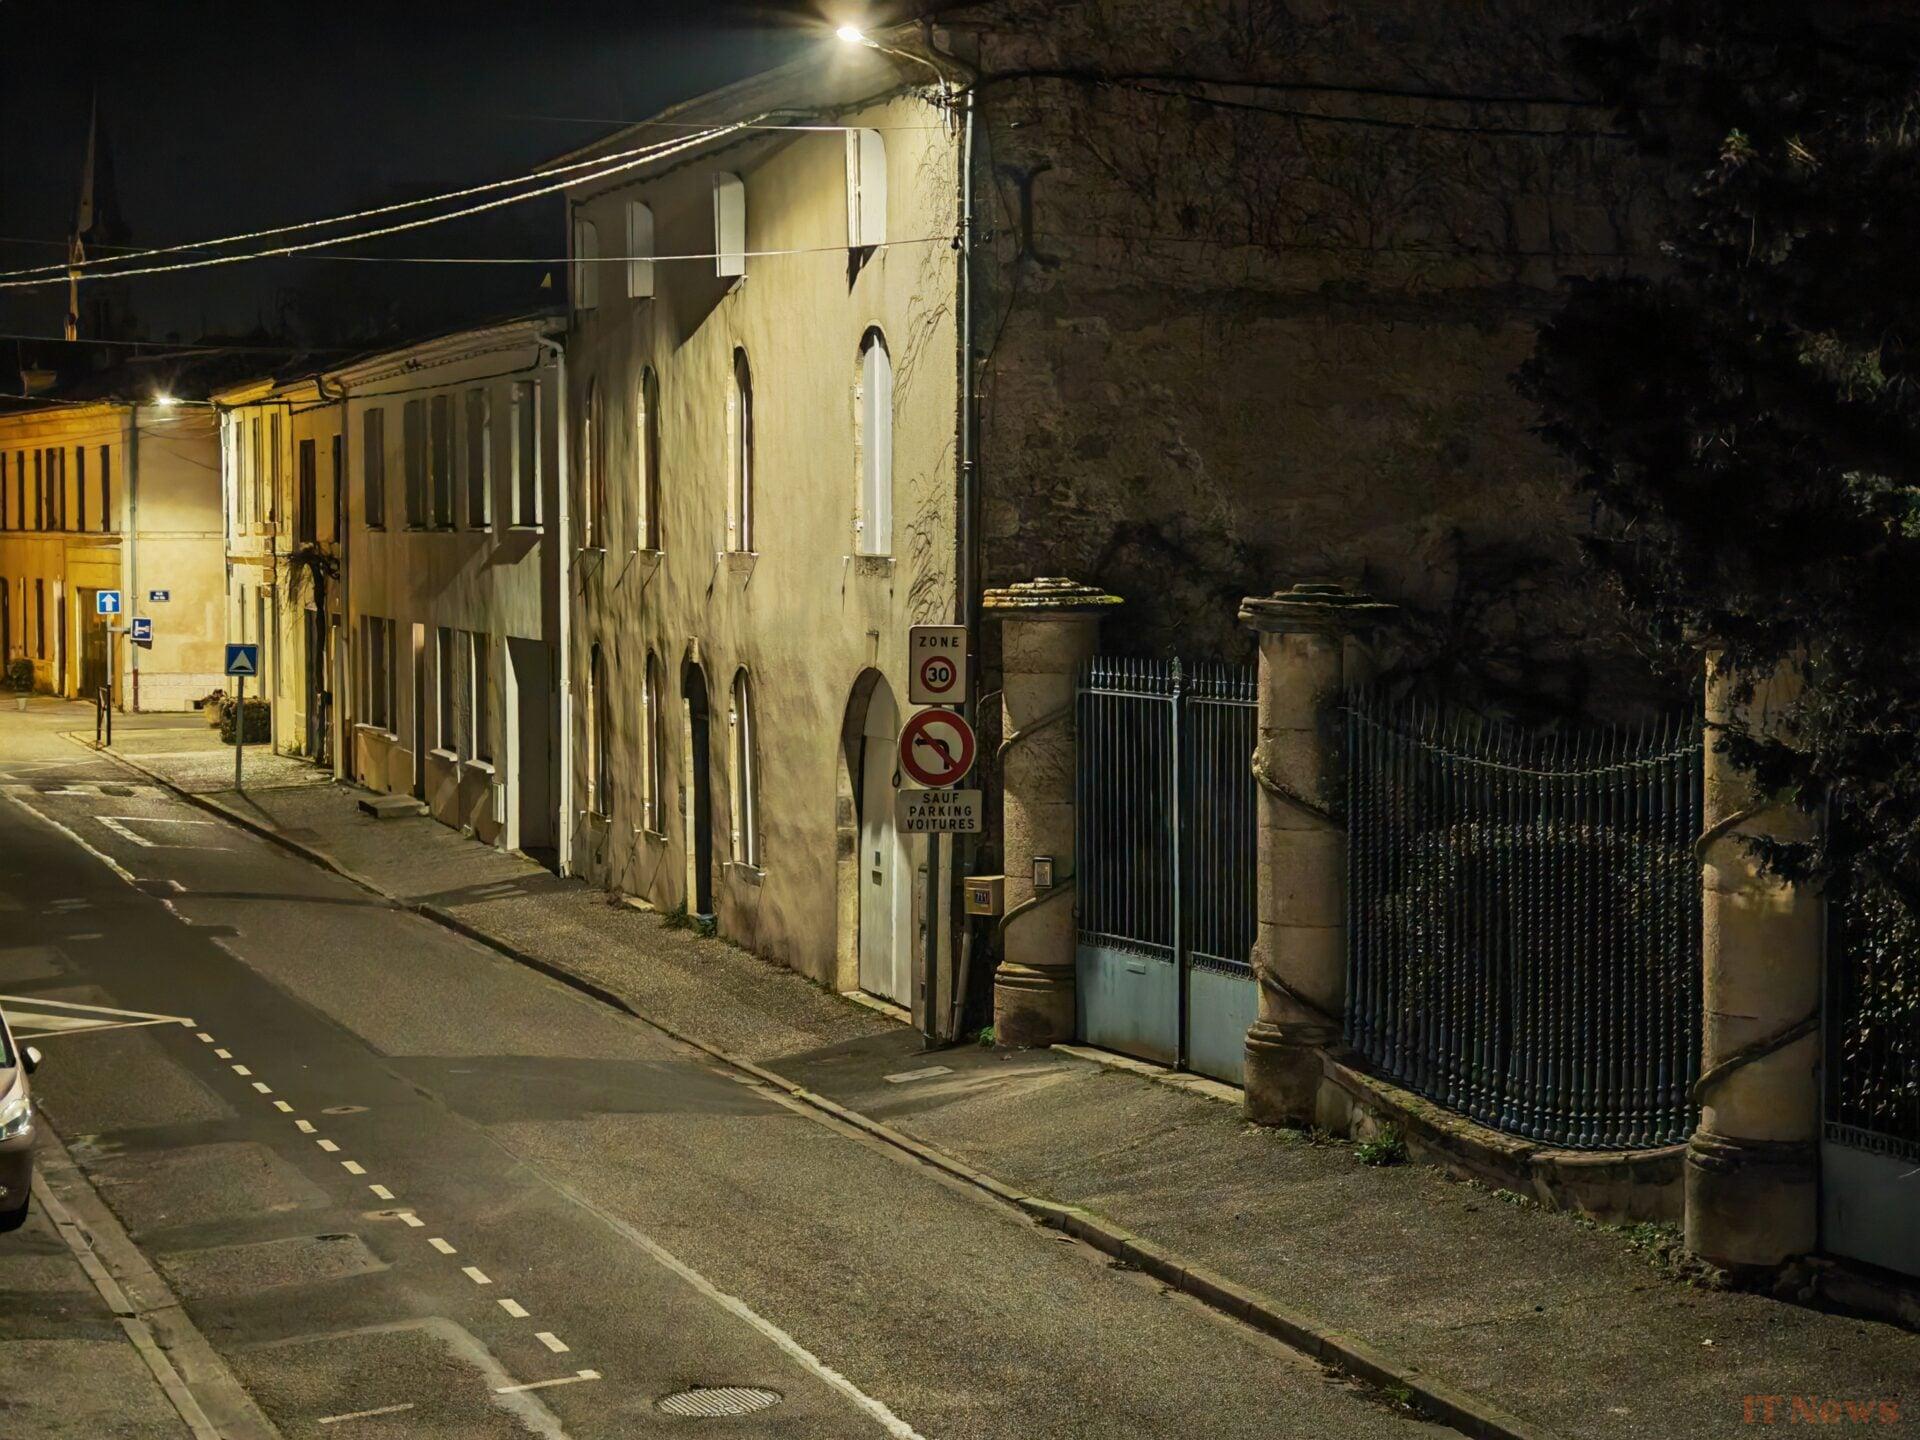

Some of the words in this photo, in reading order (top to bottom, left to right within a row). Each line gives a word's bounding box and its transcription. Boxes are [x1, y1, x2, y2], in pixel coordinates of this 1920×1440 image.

[919, 637, 960, 647] ZONE
[928, 667, 950, 683] 30
[923, 793, 960, 804] SAUF
[909, 806, 972, 817] PARKING
[907, 818, 975, 830] VOITURES
